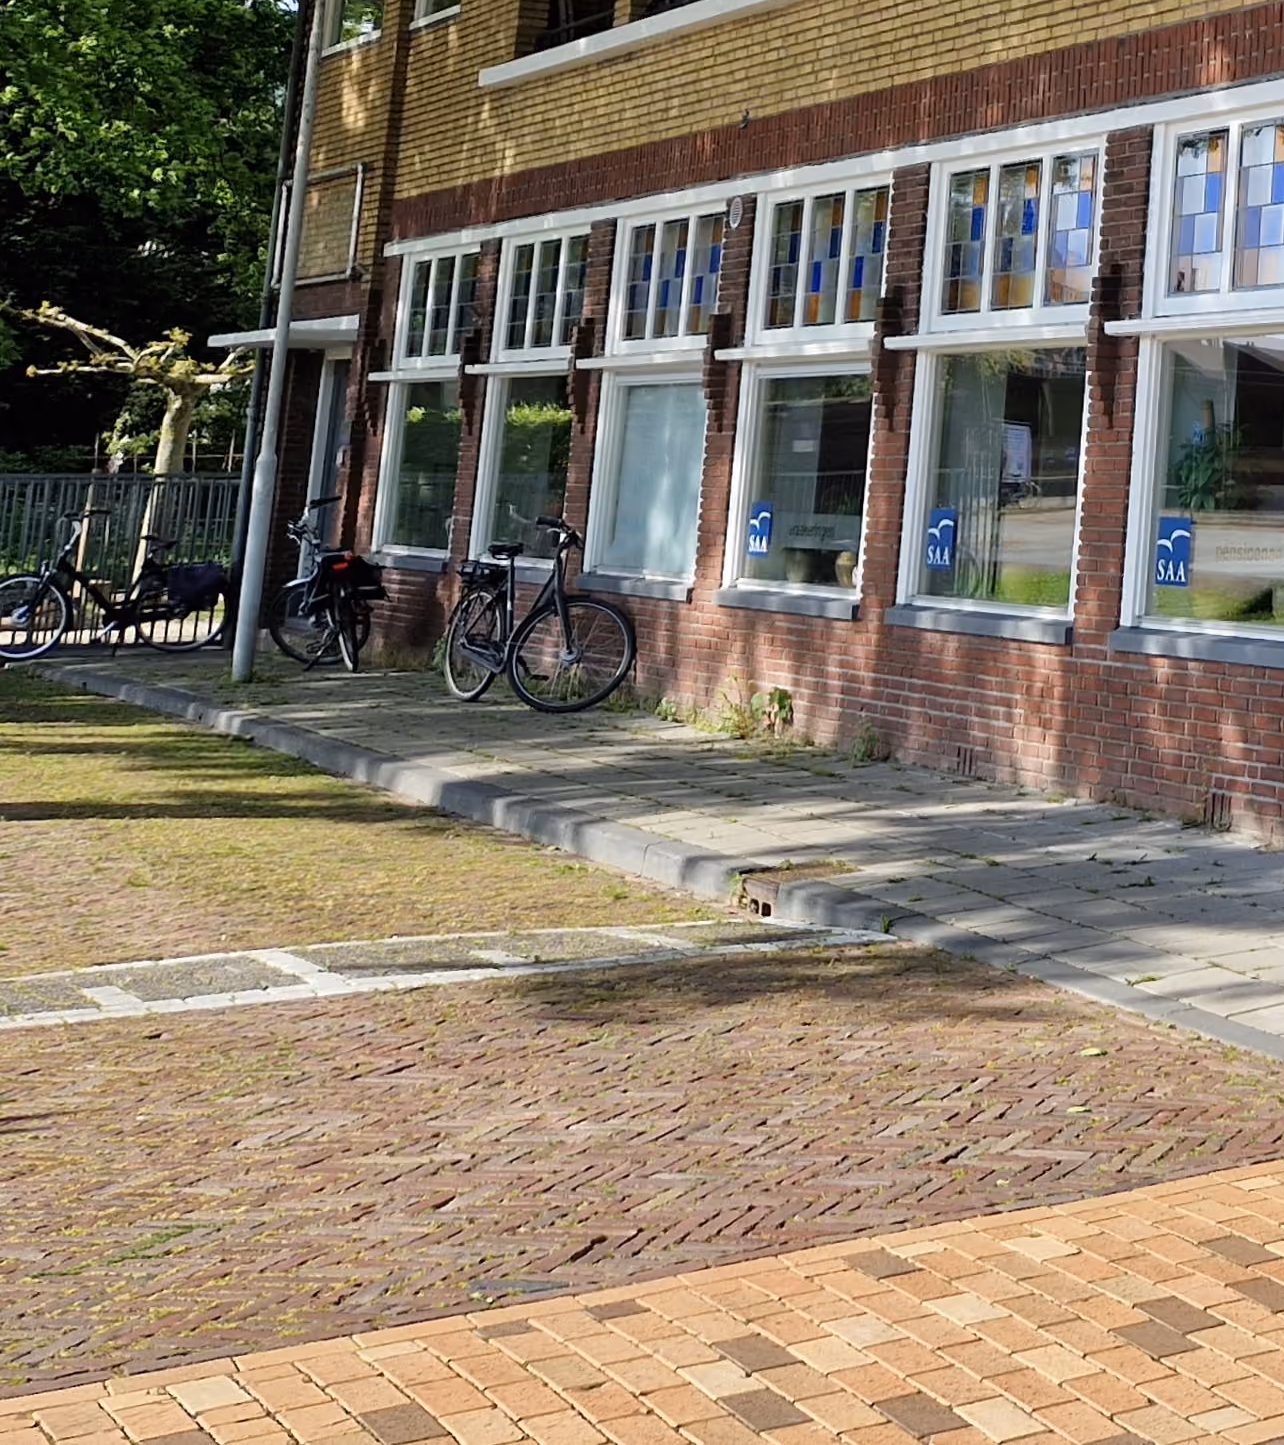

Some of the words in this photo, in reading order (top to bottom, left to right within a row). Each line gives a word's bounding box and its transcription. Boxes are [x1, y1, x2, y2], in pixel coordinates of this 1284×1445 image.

[748, 535, 768, 553] SAA
[926, 545, 950, 565] SAA
[1156, 558, 1186, 582] SAA
